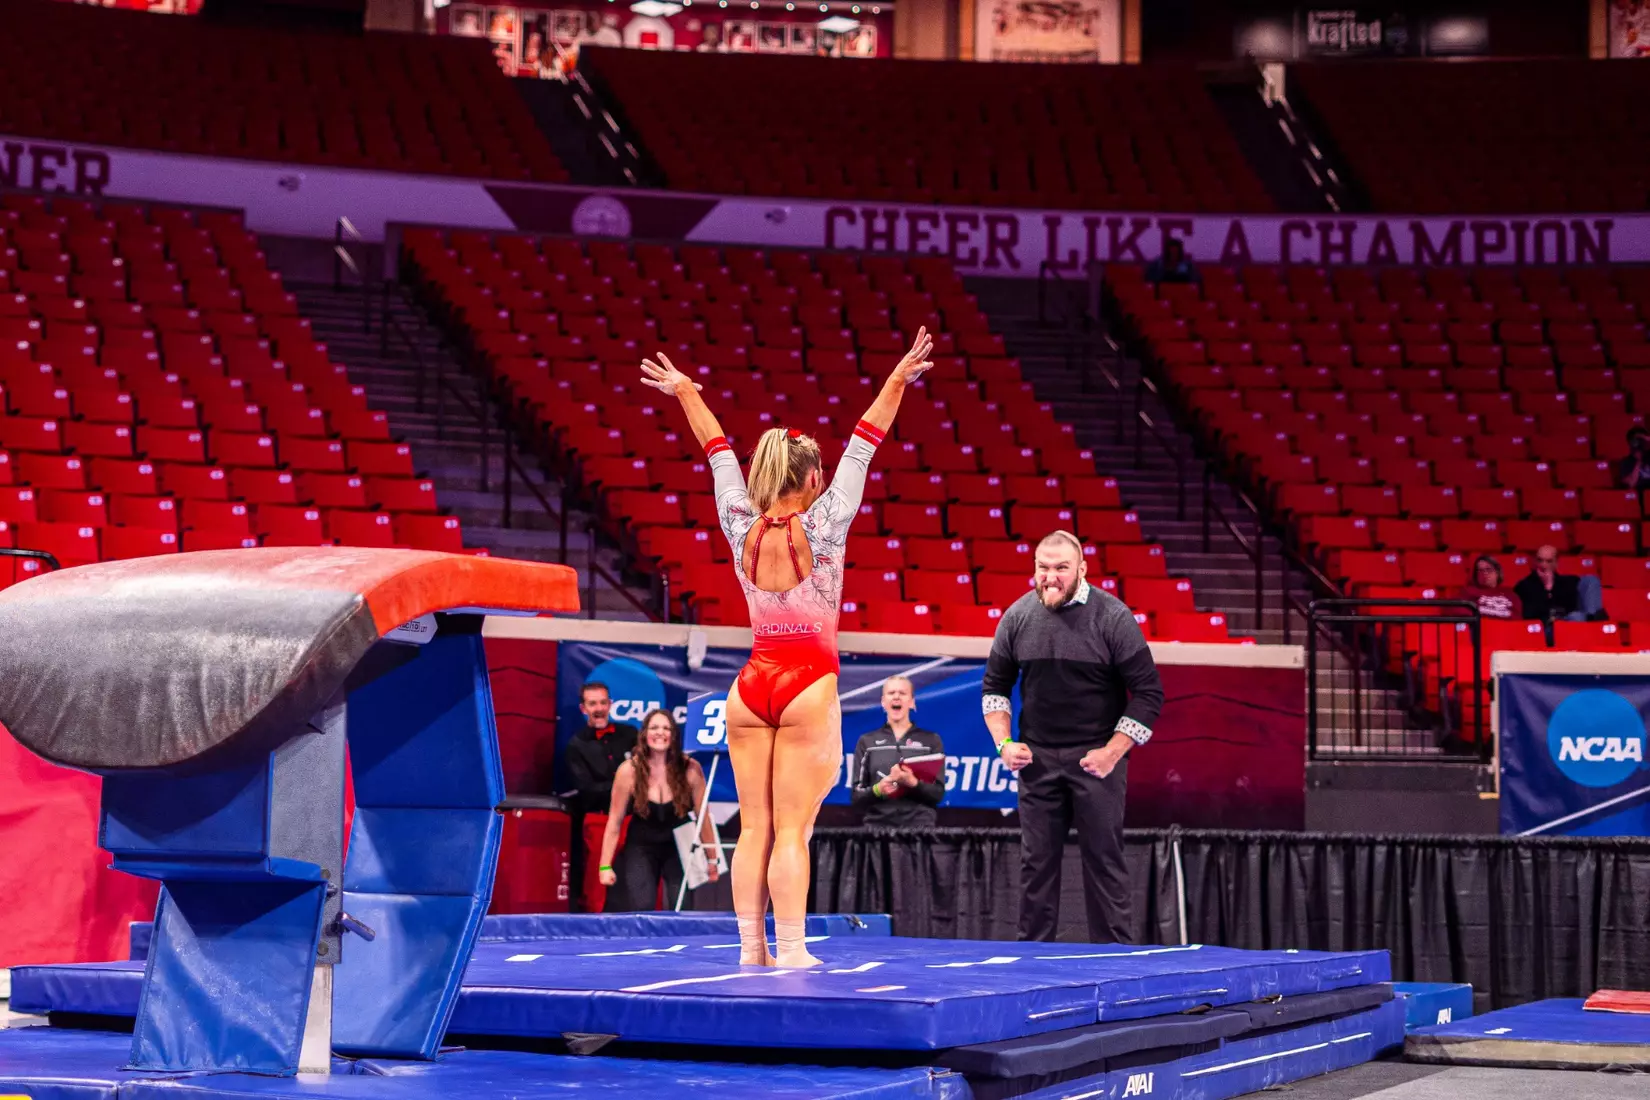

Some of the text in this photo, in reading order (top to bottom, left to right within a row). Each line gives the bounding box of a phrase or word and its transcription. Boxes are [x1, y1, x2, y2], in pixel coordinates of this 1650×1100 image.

[824, 205, 1614, 271] CHEER LIKE A CHAMPION
[696, 700, 729, 745] 3
[1558, 736, 1643, 762] NCAA
